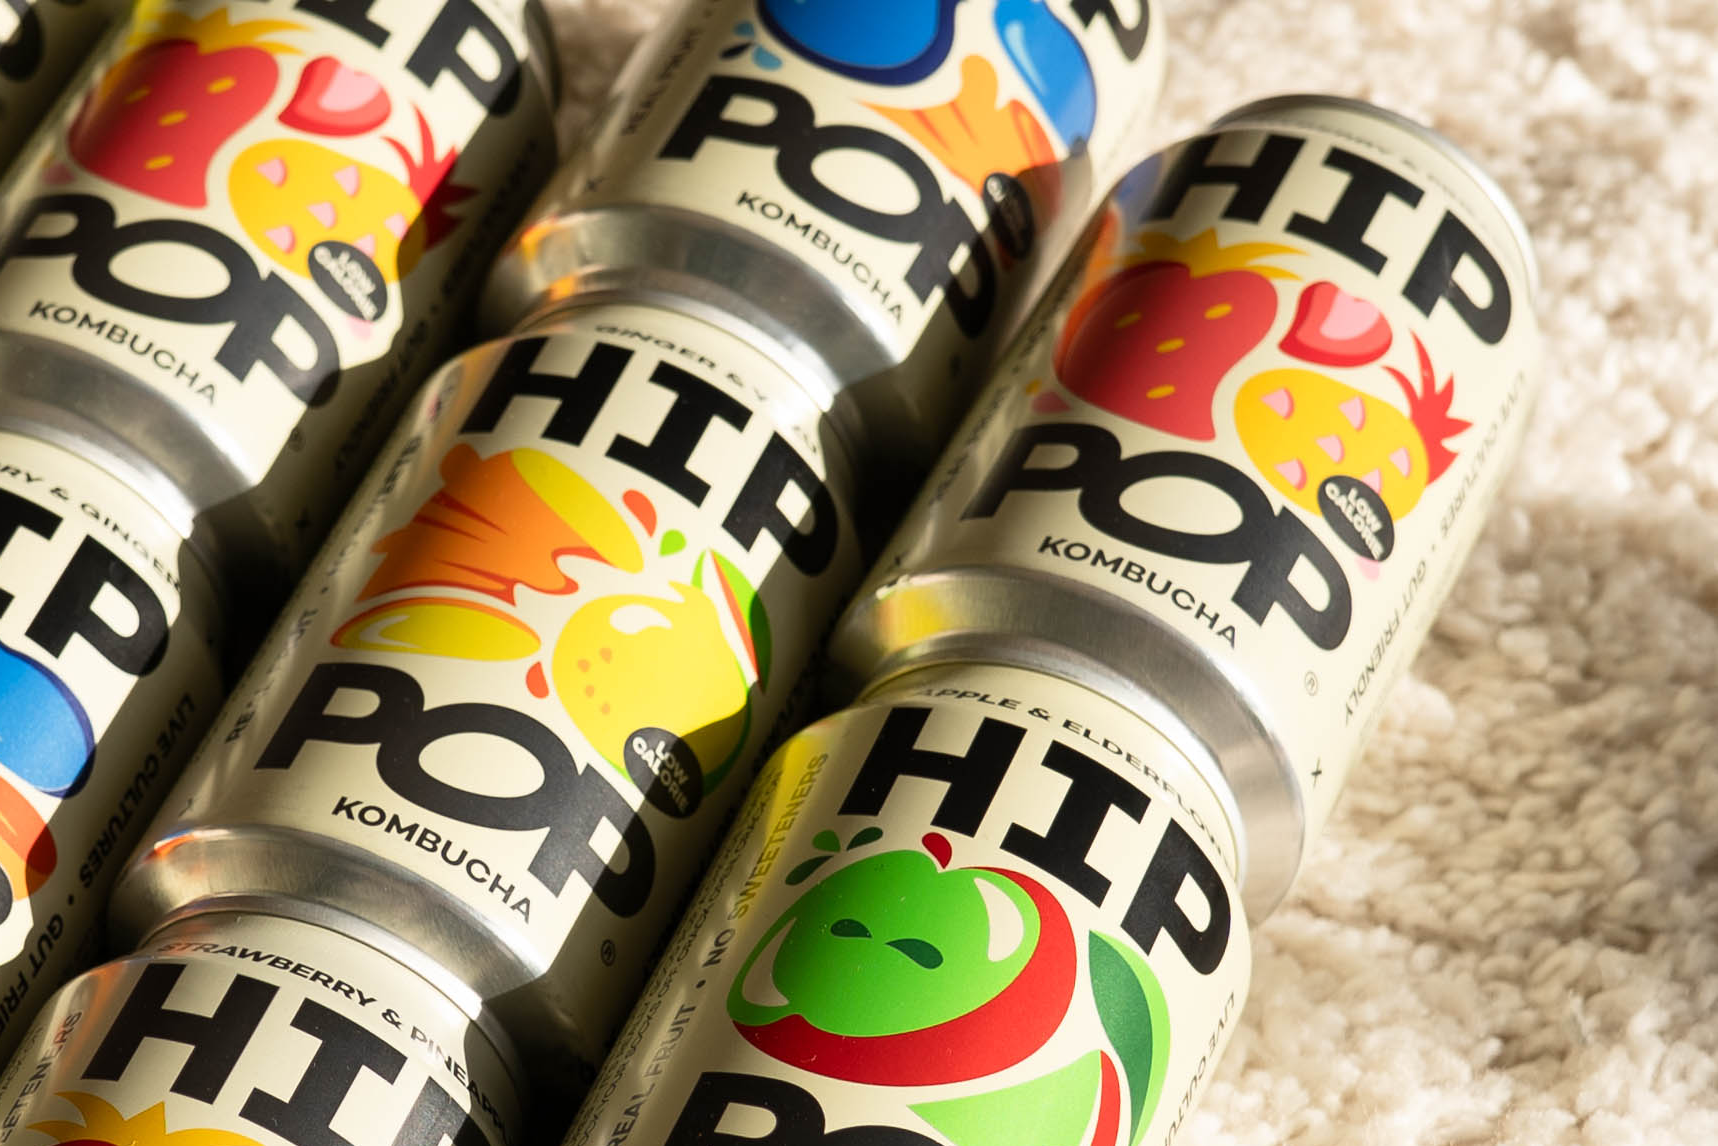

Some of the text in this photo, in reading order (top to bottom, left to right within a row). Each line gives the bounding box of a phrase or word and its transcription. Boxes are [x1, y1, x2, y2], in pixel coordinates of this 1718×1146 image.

[658, 75, 996, 339] POP
[737, 191, 904, 326] KOMBUCHA
[1145, 131, 1512, 347] HIP
[29, 300, 218, 406] KOMBUCHA
[595, 324, 718, 370] GINGER
[462, 337, 839, 577] HIP
[1348, 487, 1382, 534] LOW
[960, 422, 1352, 651] POP
[1037, 535, 1238, 649] KOMBUCHA
[1401, 560, 1428, 611] GUT
[914, 687, 1021, 712] APPLE
[1027, 707, 1051, 721] &
[1343, 605, 1402, 727] FRIENDLY
[156, 693, 197, 762] LIVE
[655, 740, 690, 785] LOW
[81, 755, 161, 889] CULTURES
[253, 662, 656, 919] POP
[837, 706, 1231, 976] HIP
[331, 796, 533, 924] KOMBUCHA
[646, 1002, 697, 1080] FRUIT
[706, 926, 737, 970] NO
[732, 752, 829, 921] SWEETENERS
[31, 911, 65, 981] GUT
[158, 941, 378, 1008] STRAWBERRY
[381, 1008, 404, 1031] &
[1204, 991, 1237, 1046] LIVE
